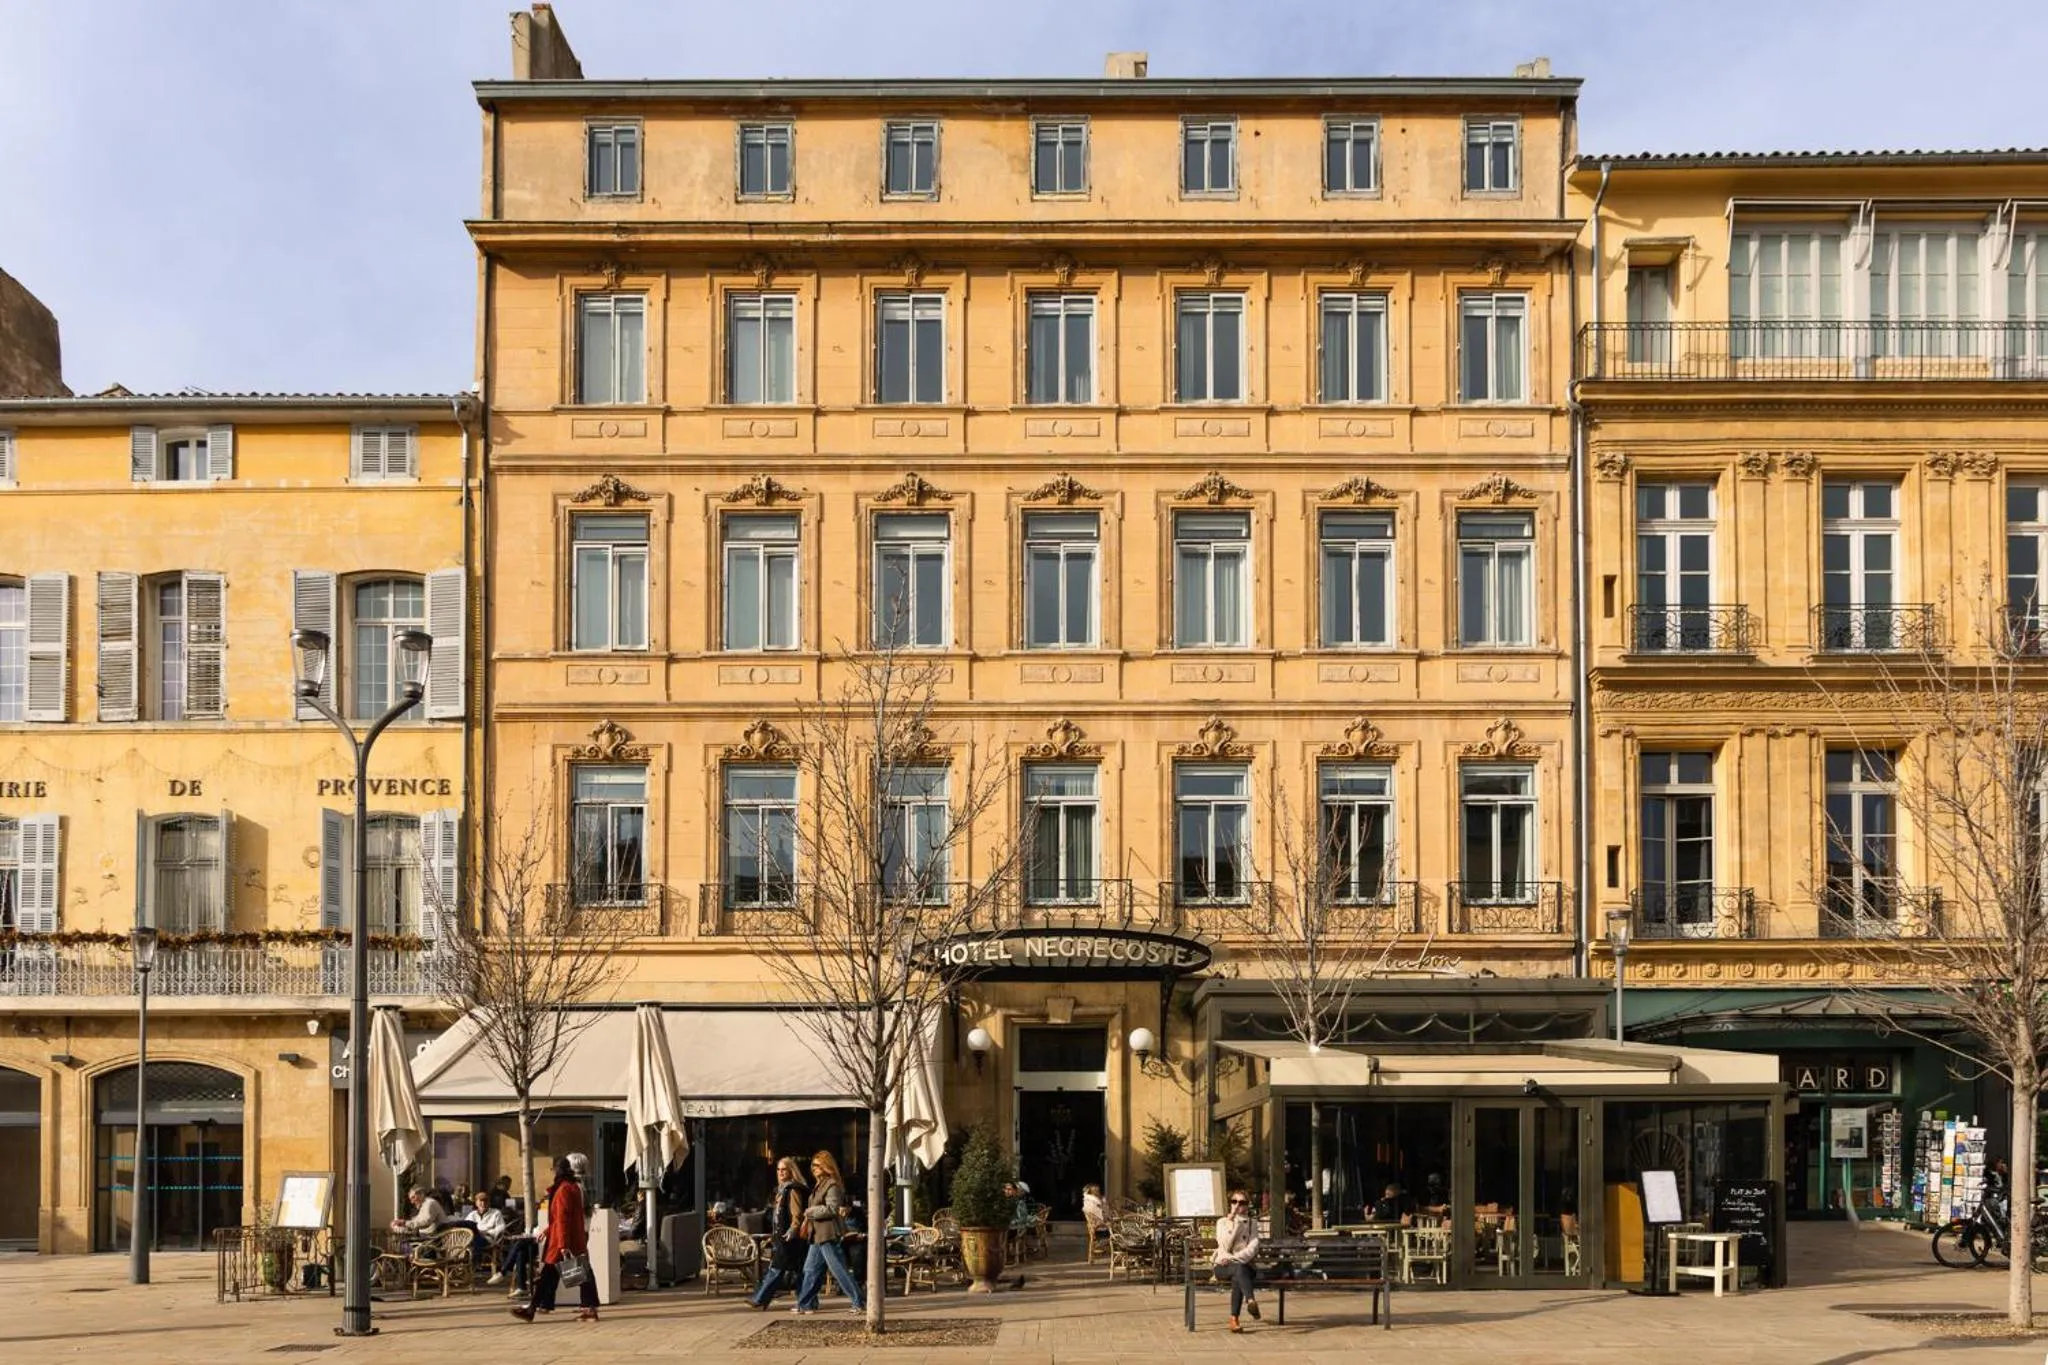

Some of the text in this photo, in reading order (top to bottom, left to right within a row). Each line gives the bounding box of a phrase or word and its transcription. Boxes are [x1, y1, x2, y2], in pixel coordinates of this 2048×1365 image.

[167, 779, 203, 797] DE
[933, 937, 1190, 967] HOTEL NEGRECOSTE
